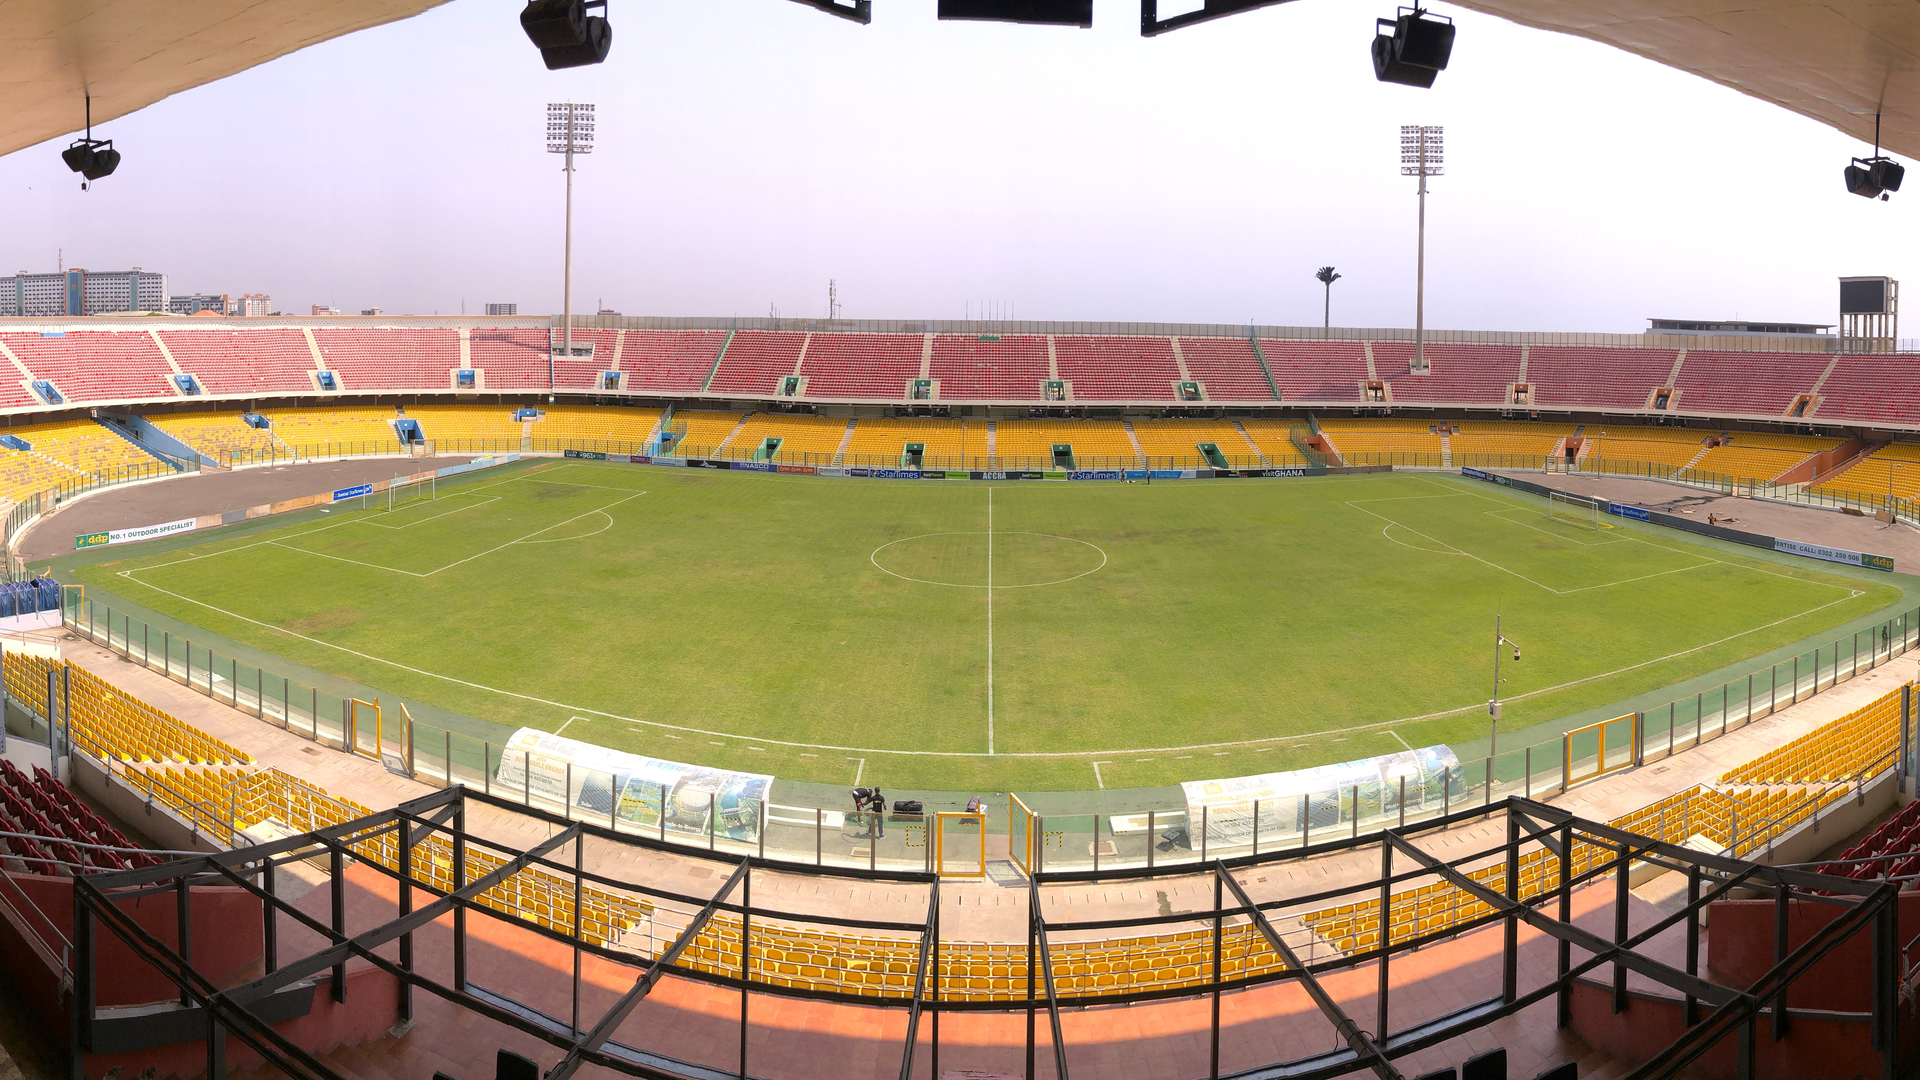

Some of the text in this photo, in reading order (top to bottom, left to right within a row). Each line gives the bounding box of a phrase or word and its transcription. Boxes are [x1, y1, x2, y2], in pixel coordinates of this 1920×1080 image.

[880, 470, 919, 479] StarTimes
[983, 472, 1006, 480] ACCRA
[1077, 471, 1116, 480] StarTimes
[1262, 470, 1304, 478] visitGHANA
[128, 528, 159, 538] OUTDOOR
[159, 521, 193, 533] SPECIALIST
[88, 534, 109, 544] ddp
[1799, 546, 1817, 554] CALL:
[1817, 549, 1833, 557] 0302
[1872, 557, 1893, 568] ddp
[516, 756, 566, 774] RENWABLE ENERGY
[663, 820, 702, 833] aste-to-Energy
